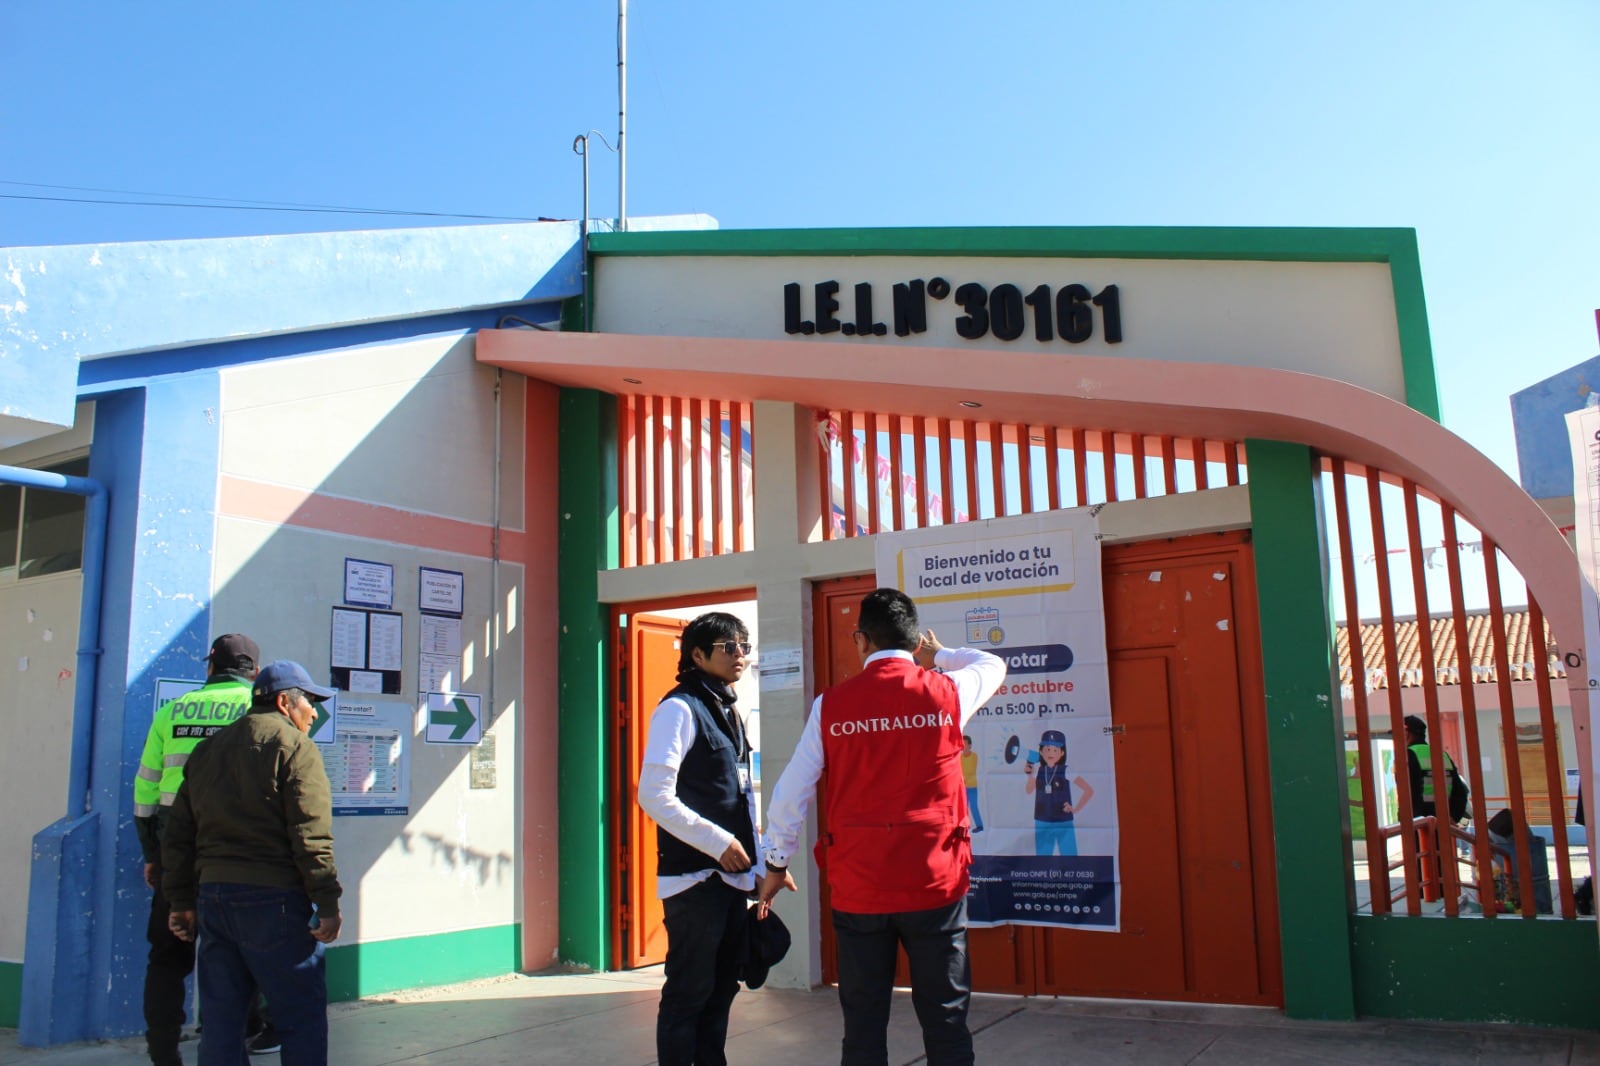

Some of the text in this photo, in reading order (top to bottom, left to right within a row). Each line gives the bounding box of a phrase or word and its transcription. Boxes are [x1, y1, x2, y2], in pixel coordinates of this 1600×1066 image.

[955, 282, 1122, 344] 30161
[924, 546, 1051, 571] Bienvenido a tu
[919, 562, 1059, 589] local de votación
[1011, 680, 1074, 694] octubre
[171, 701, 248, 721] POLICIA
[995, 706, 1003, 715] a
[1006, 703, 1035, 715] 5:00
[1039, 704, 1052, 717] p.
[1055, 703, 1075, 713] m.
[830, 710, 953, 737] CONTRALORÍA
[1011, 870, 1028, 878] Fono
